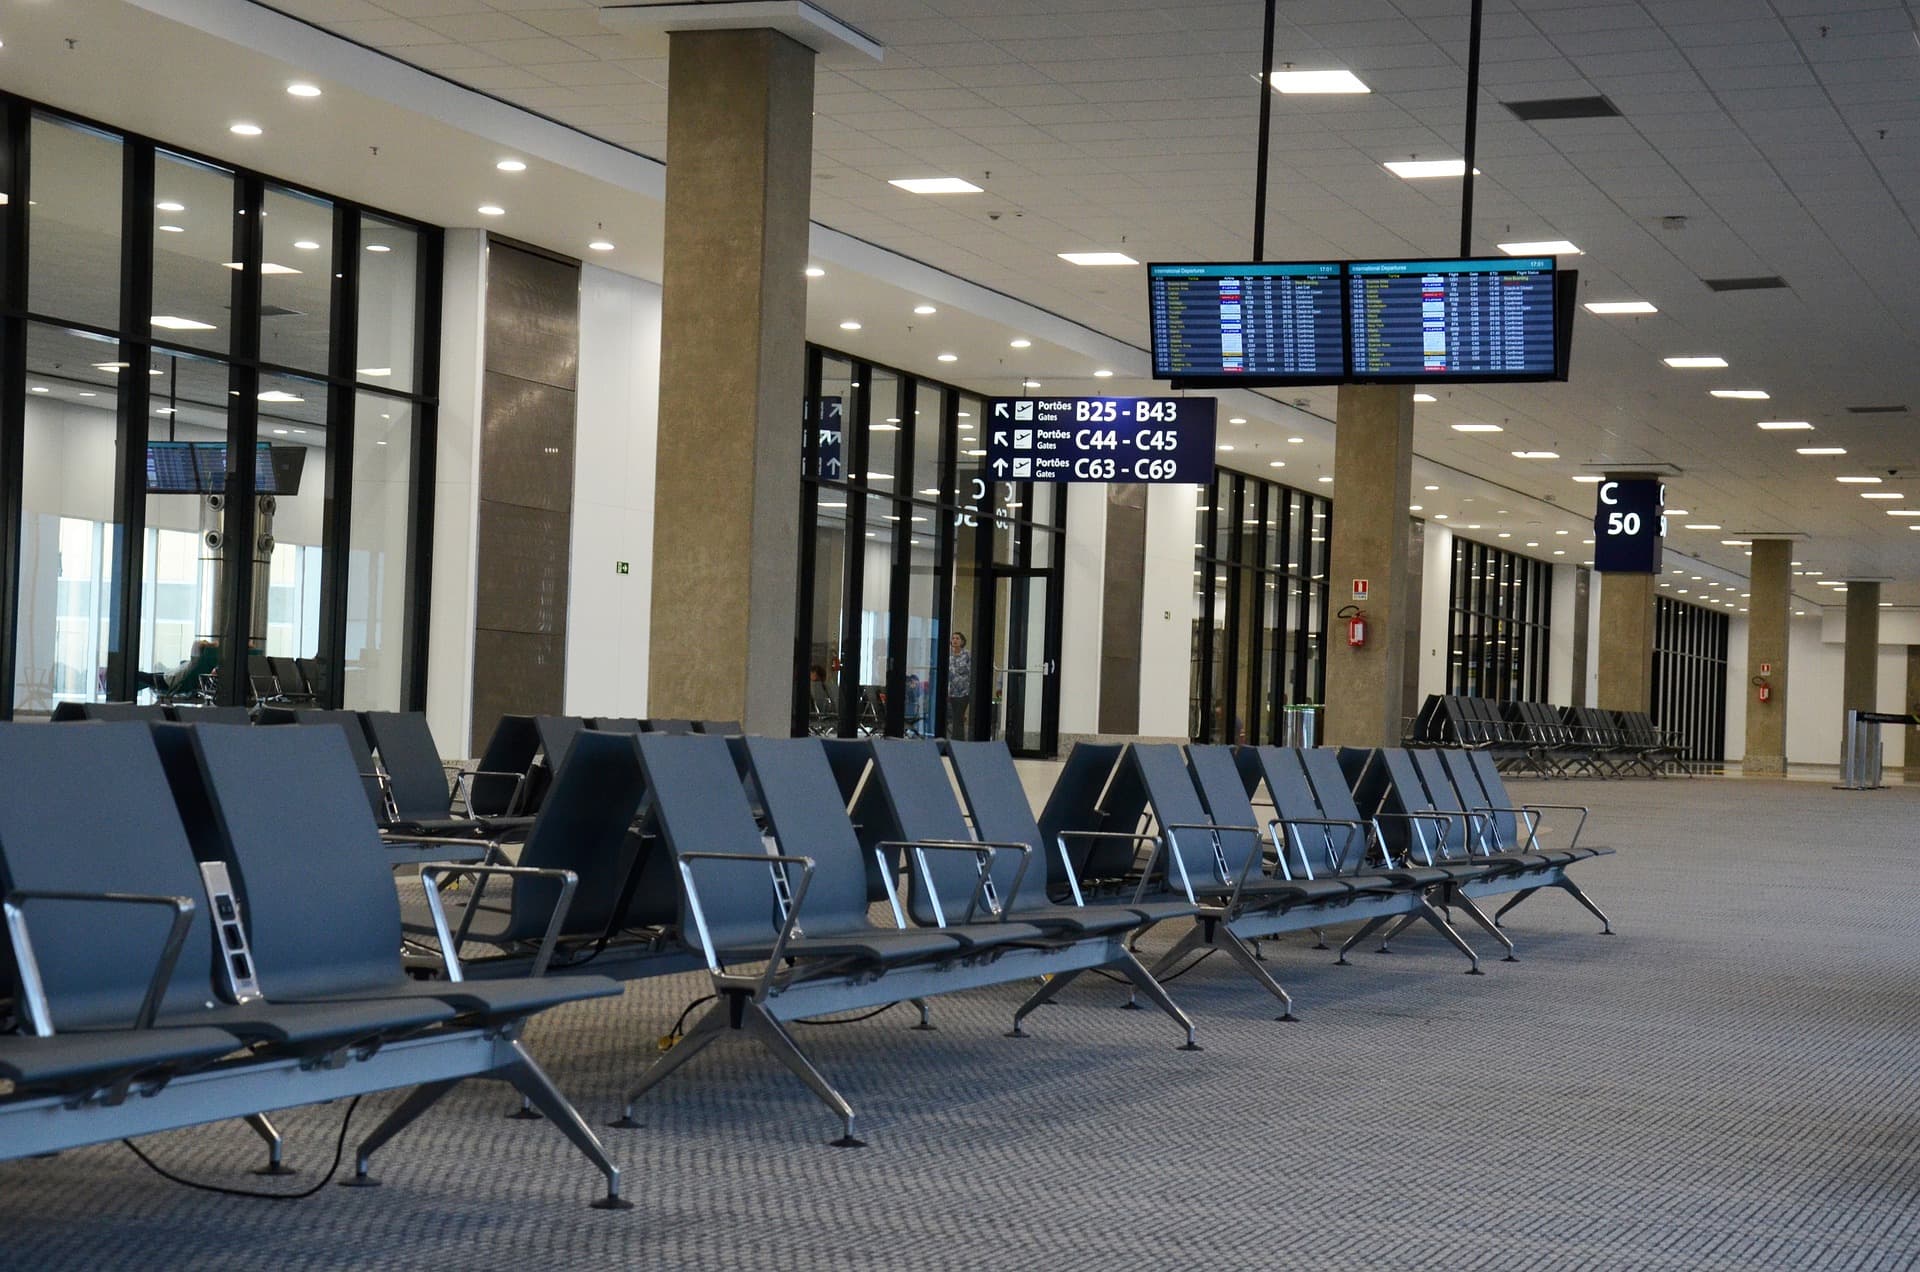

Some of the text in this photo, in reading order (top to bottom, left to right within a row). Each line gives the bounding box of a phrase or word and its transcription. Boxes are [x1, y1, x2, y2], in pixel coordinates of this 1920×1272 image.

[1038, 401, 1072, 411] Portões
[1076, 401, 1116, 422] B25
[1136, 401, 1177, 422] B43
[1038, 413, 1057, 422] Gates
[1037, 429, 1071, 439] Portões
[1075, 430, 1117, 450] C44
[1135, 430, 1177, 450] C45
[1037, 442, 1056, 450] Gates
[1036, 458, 1069, 468] Portões
[1074, 458, 1115, 479] C63
[1134, 458, 1176, 479] C69
[1036, 470, 1055, 478] Gates
[1600, 482, 1619, 505] C
[1608, 512, 1640, 535] 50
